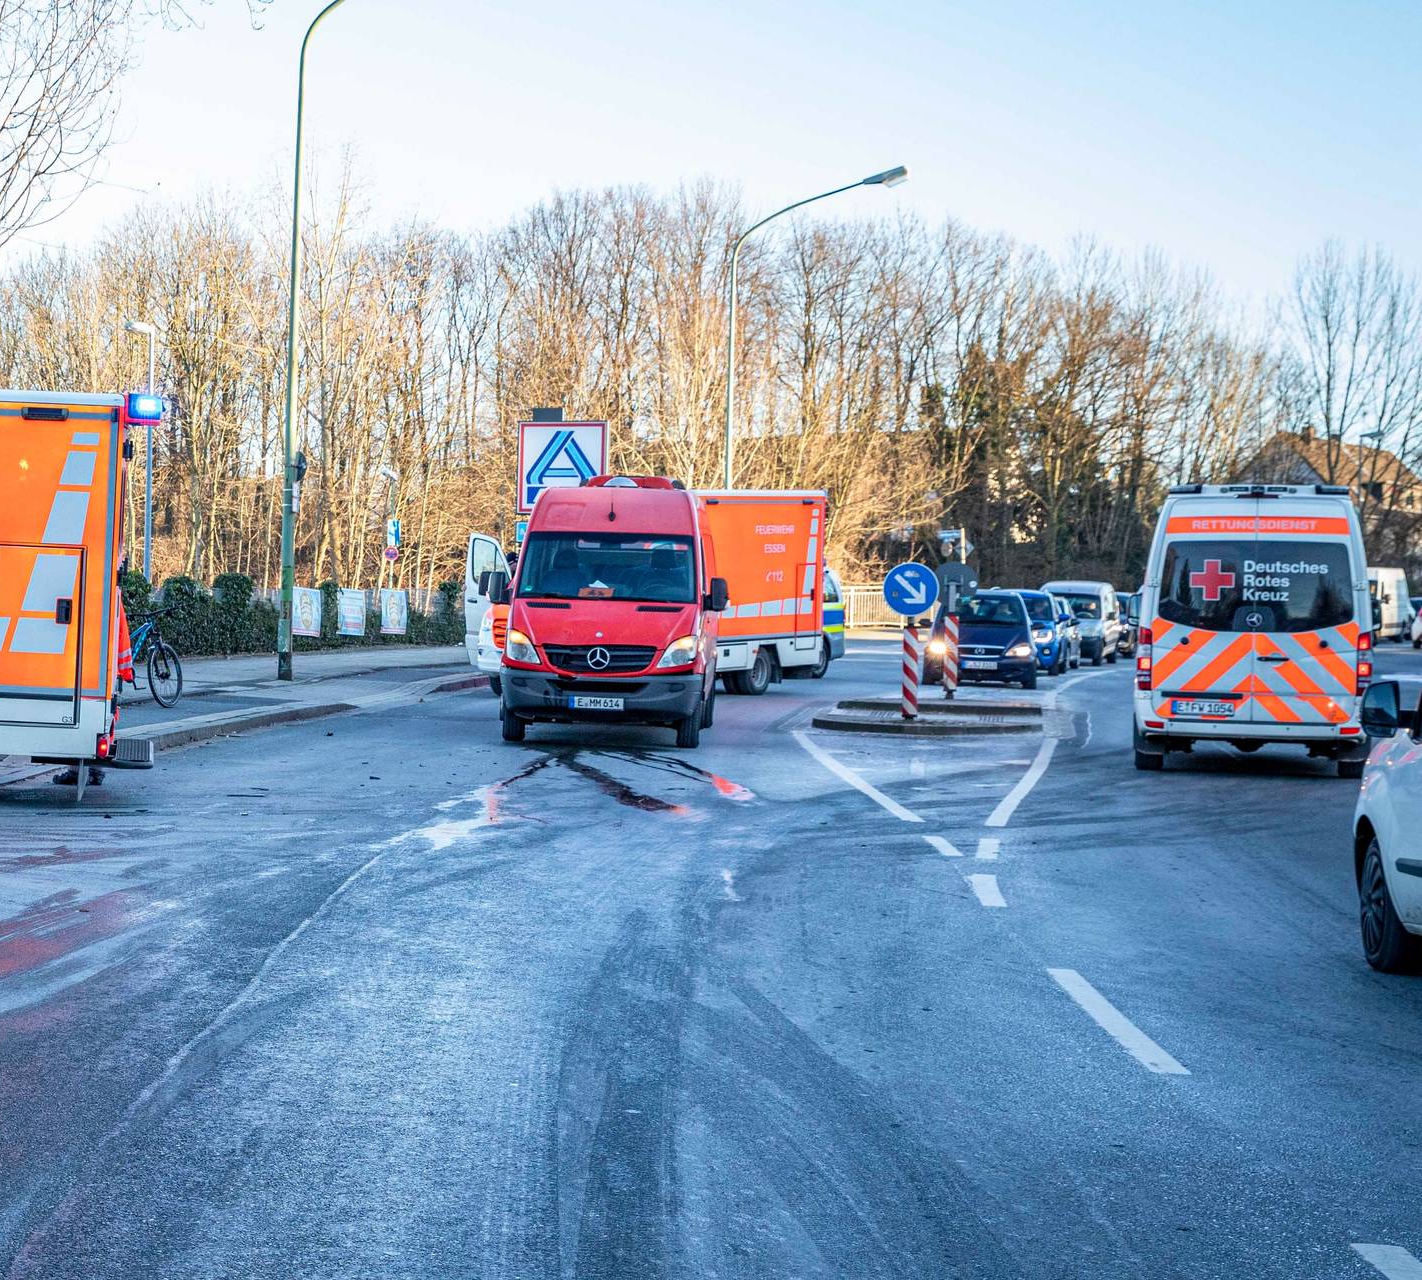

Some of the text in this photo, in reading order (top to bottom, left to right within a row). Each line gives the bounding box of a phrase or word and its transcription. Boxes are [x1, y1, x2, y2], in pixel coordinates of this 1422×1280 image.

[1191, 519, 1318, 531] RETTUNGSDIENST
[1243, 560, 1329, 575] Deutsches
[1242, 574, 1291, 588] Rotes
[1242, 588, 1290, 602] Kreuz
[577, 698, 620, 708] E MM 614
[1177, 702, 1233, 714] E FW 1054
[61, 715, 73, 723] G3
